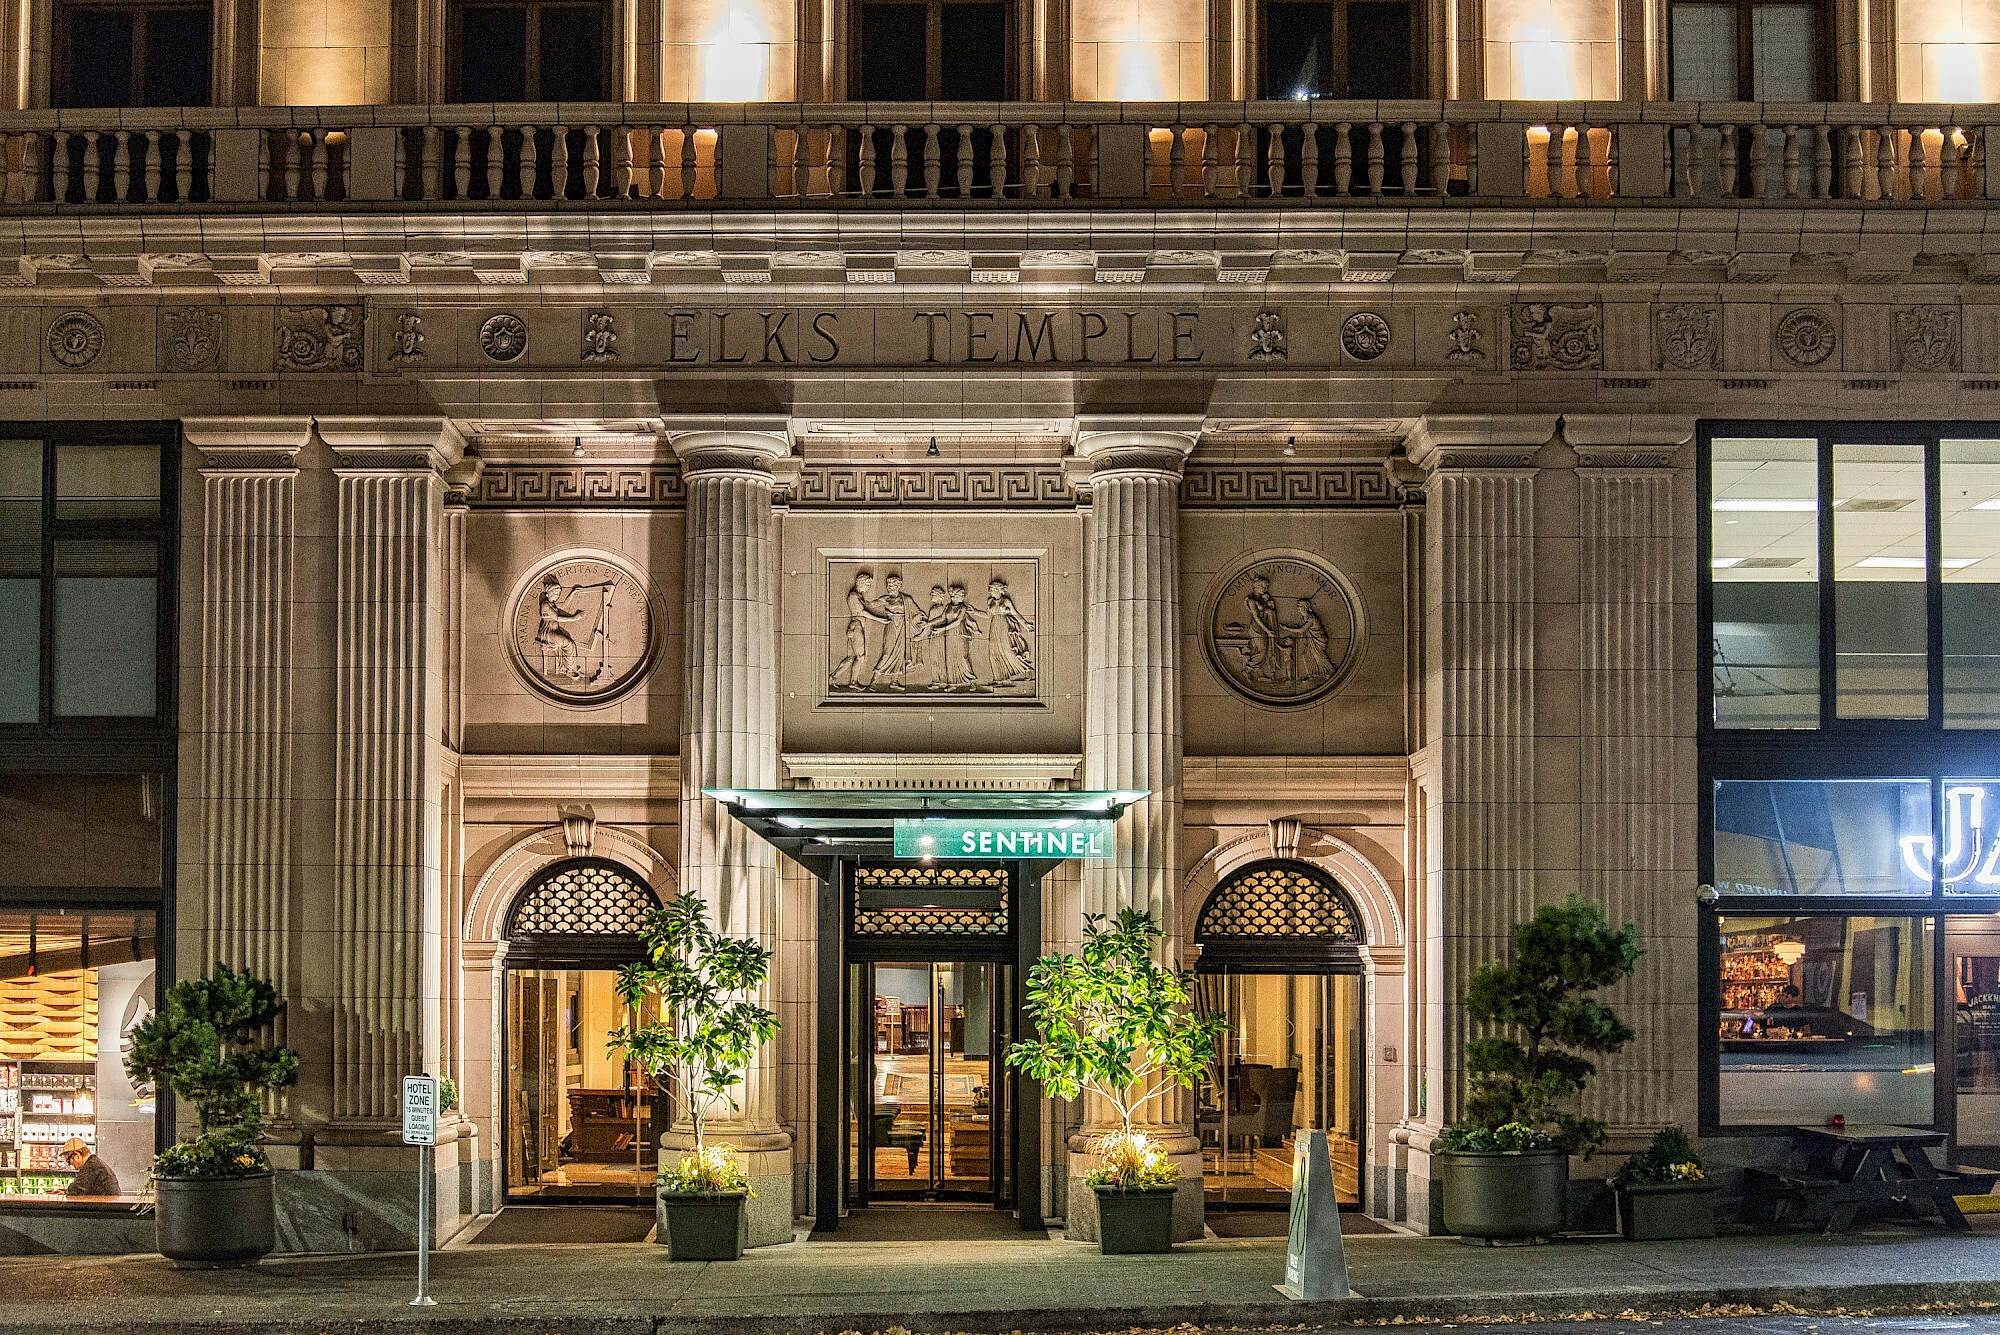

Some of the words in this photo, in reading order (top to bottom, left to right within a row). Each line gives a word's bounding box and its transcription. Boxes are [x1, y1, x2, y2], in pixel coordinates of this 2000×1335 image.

[665, 311, 841, 364] ELKS
[912, 311, 1205, 364] TEMPLE
[1228, 570, 1259, 597] OMNIA
[1265, 564, 1305, 576] VINCIT
[1308, 575, 1338, 600] AMOR
[519, 604, 532, 644] MAGNA
[554, 564, 599, 579] ERITAS
[603, 568, 619, 581] ET
[961, 830, 1102, 854] SENTINEL
[407, 1083, 431, 1094] HOTEL
[409, 1095, 429, 1105] ZONE
